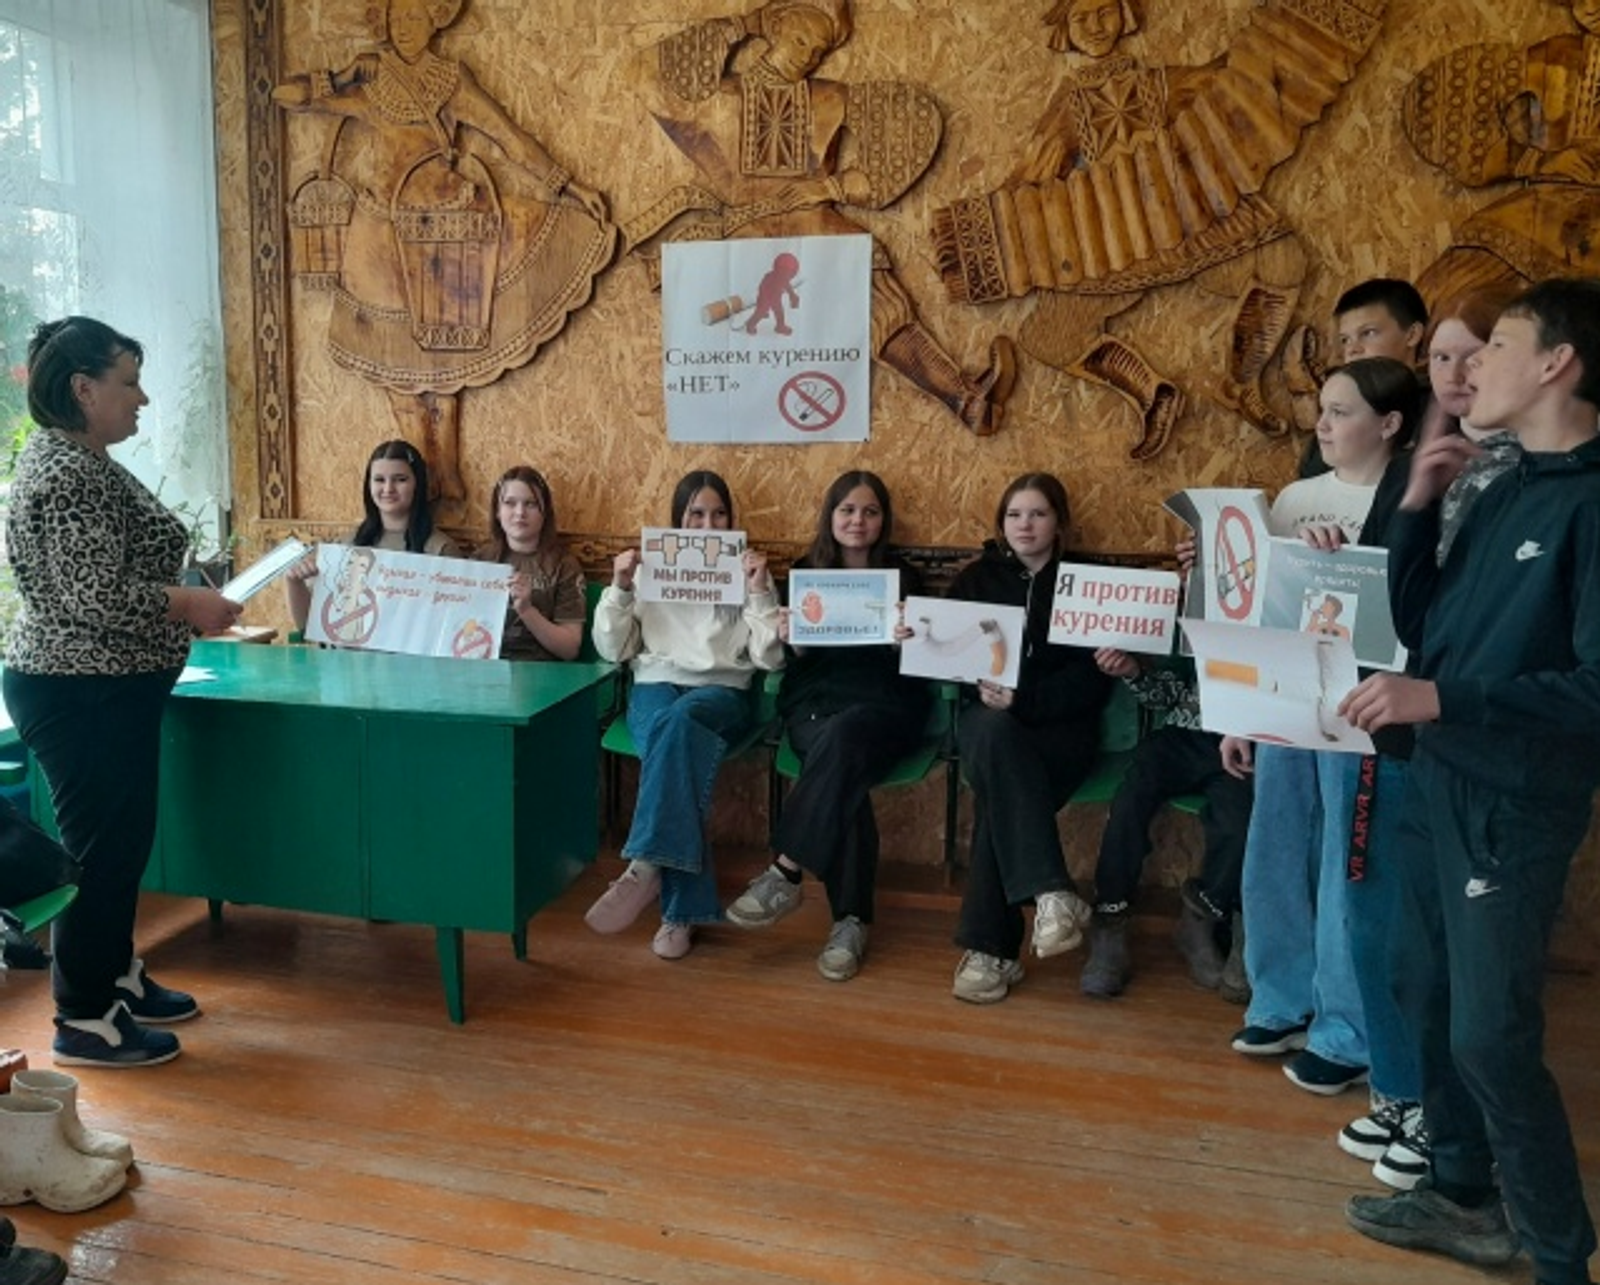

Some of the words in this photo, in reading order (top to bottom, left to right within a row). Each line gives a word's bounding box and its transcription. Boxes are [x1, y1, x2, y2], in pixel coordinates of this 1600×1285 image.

[665, 348, 751, 366] Скажем
[758, 347, 861, 369] курению
[667, 375, 740, 394] «НЕТ»
[653, 568, 677, 580] МЫ
[680, 569, 732, 585] ПРОТИВ
[661, 587, 723, 602] КУРЕНИЯ
[1057, 573, 1075, 597] Я
[1081, 580, 1178, 606] против
[1053, 608, 1166, 637] курения
